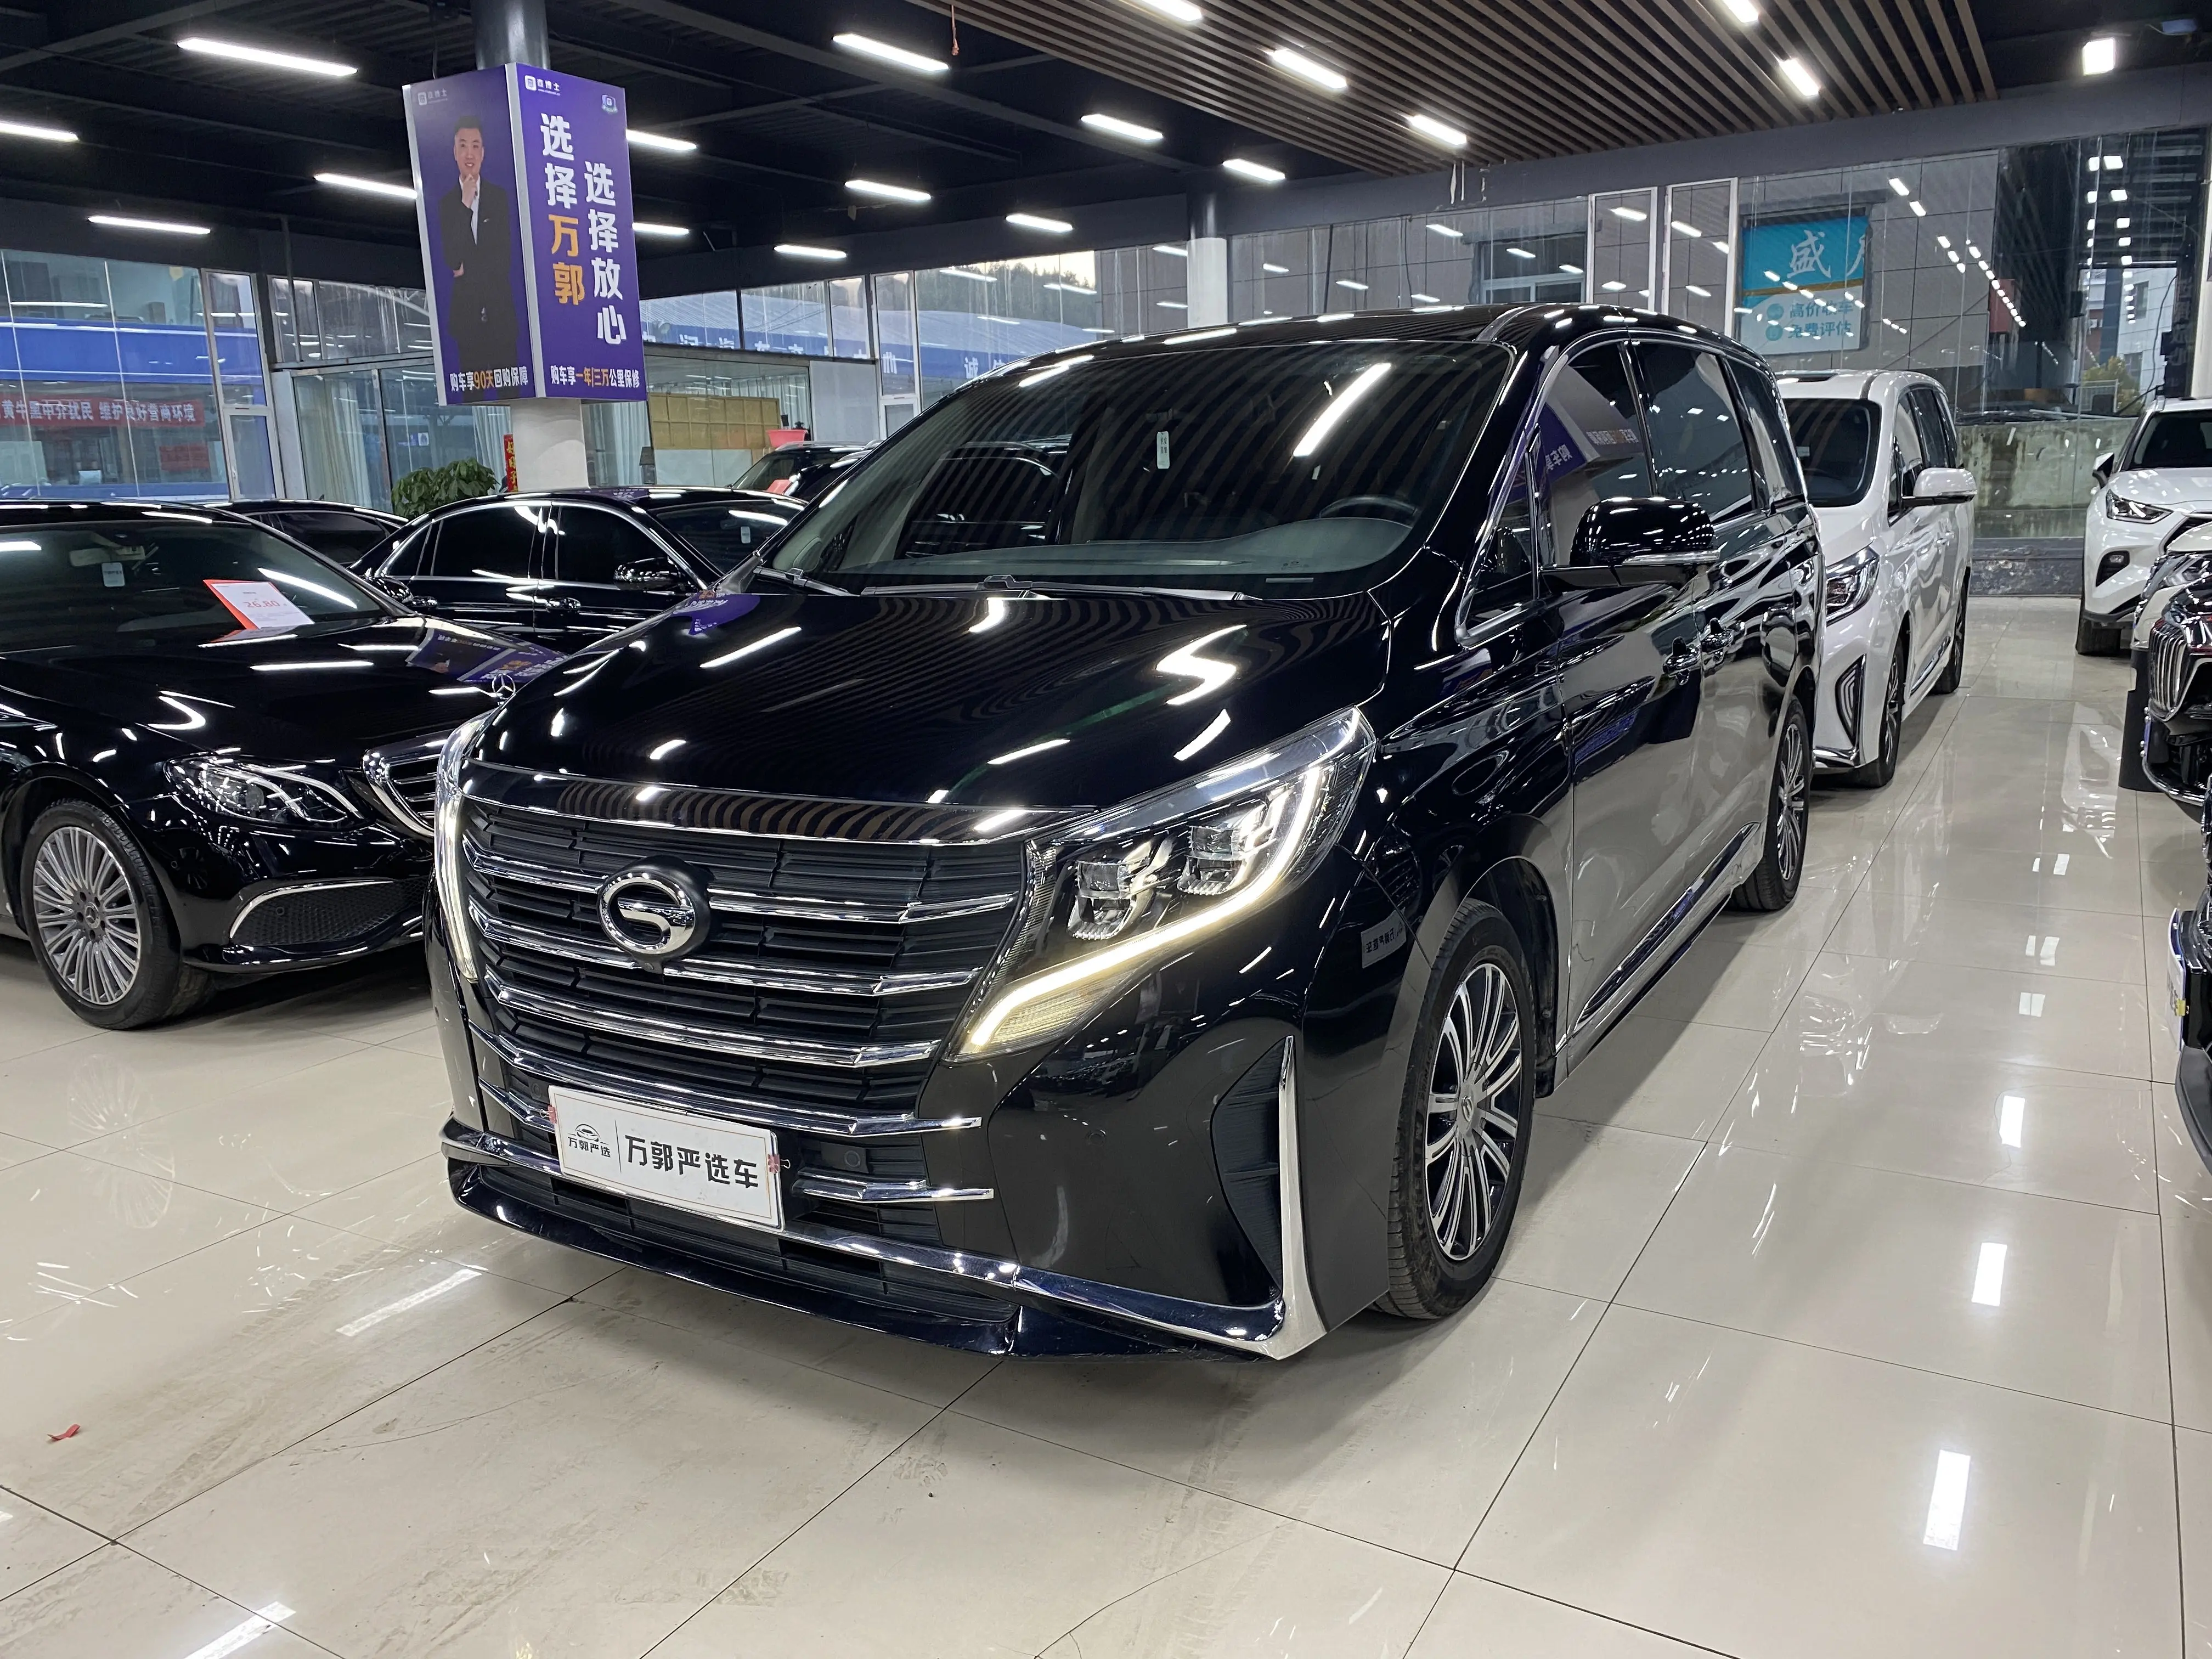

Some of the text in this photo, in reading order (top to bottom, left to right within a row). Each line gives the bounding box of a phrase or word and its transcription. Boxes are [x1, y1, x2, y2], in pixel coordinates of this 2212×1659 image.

[540, 112, 585, 306] 选择万郭
[584, 161, 627, 345] 选择放心
[1788, 320, 1852, 338] 免费评估
[450, 366, 528, 391] 购车享90天回购保障
[242, 600, 280, 608] 26.80
[568, 1137, 611, 1158] 万郭严选
[625, 1135, 759, 1188] 万郭严选车
